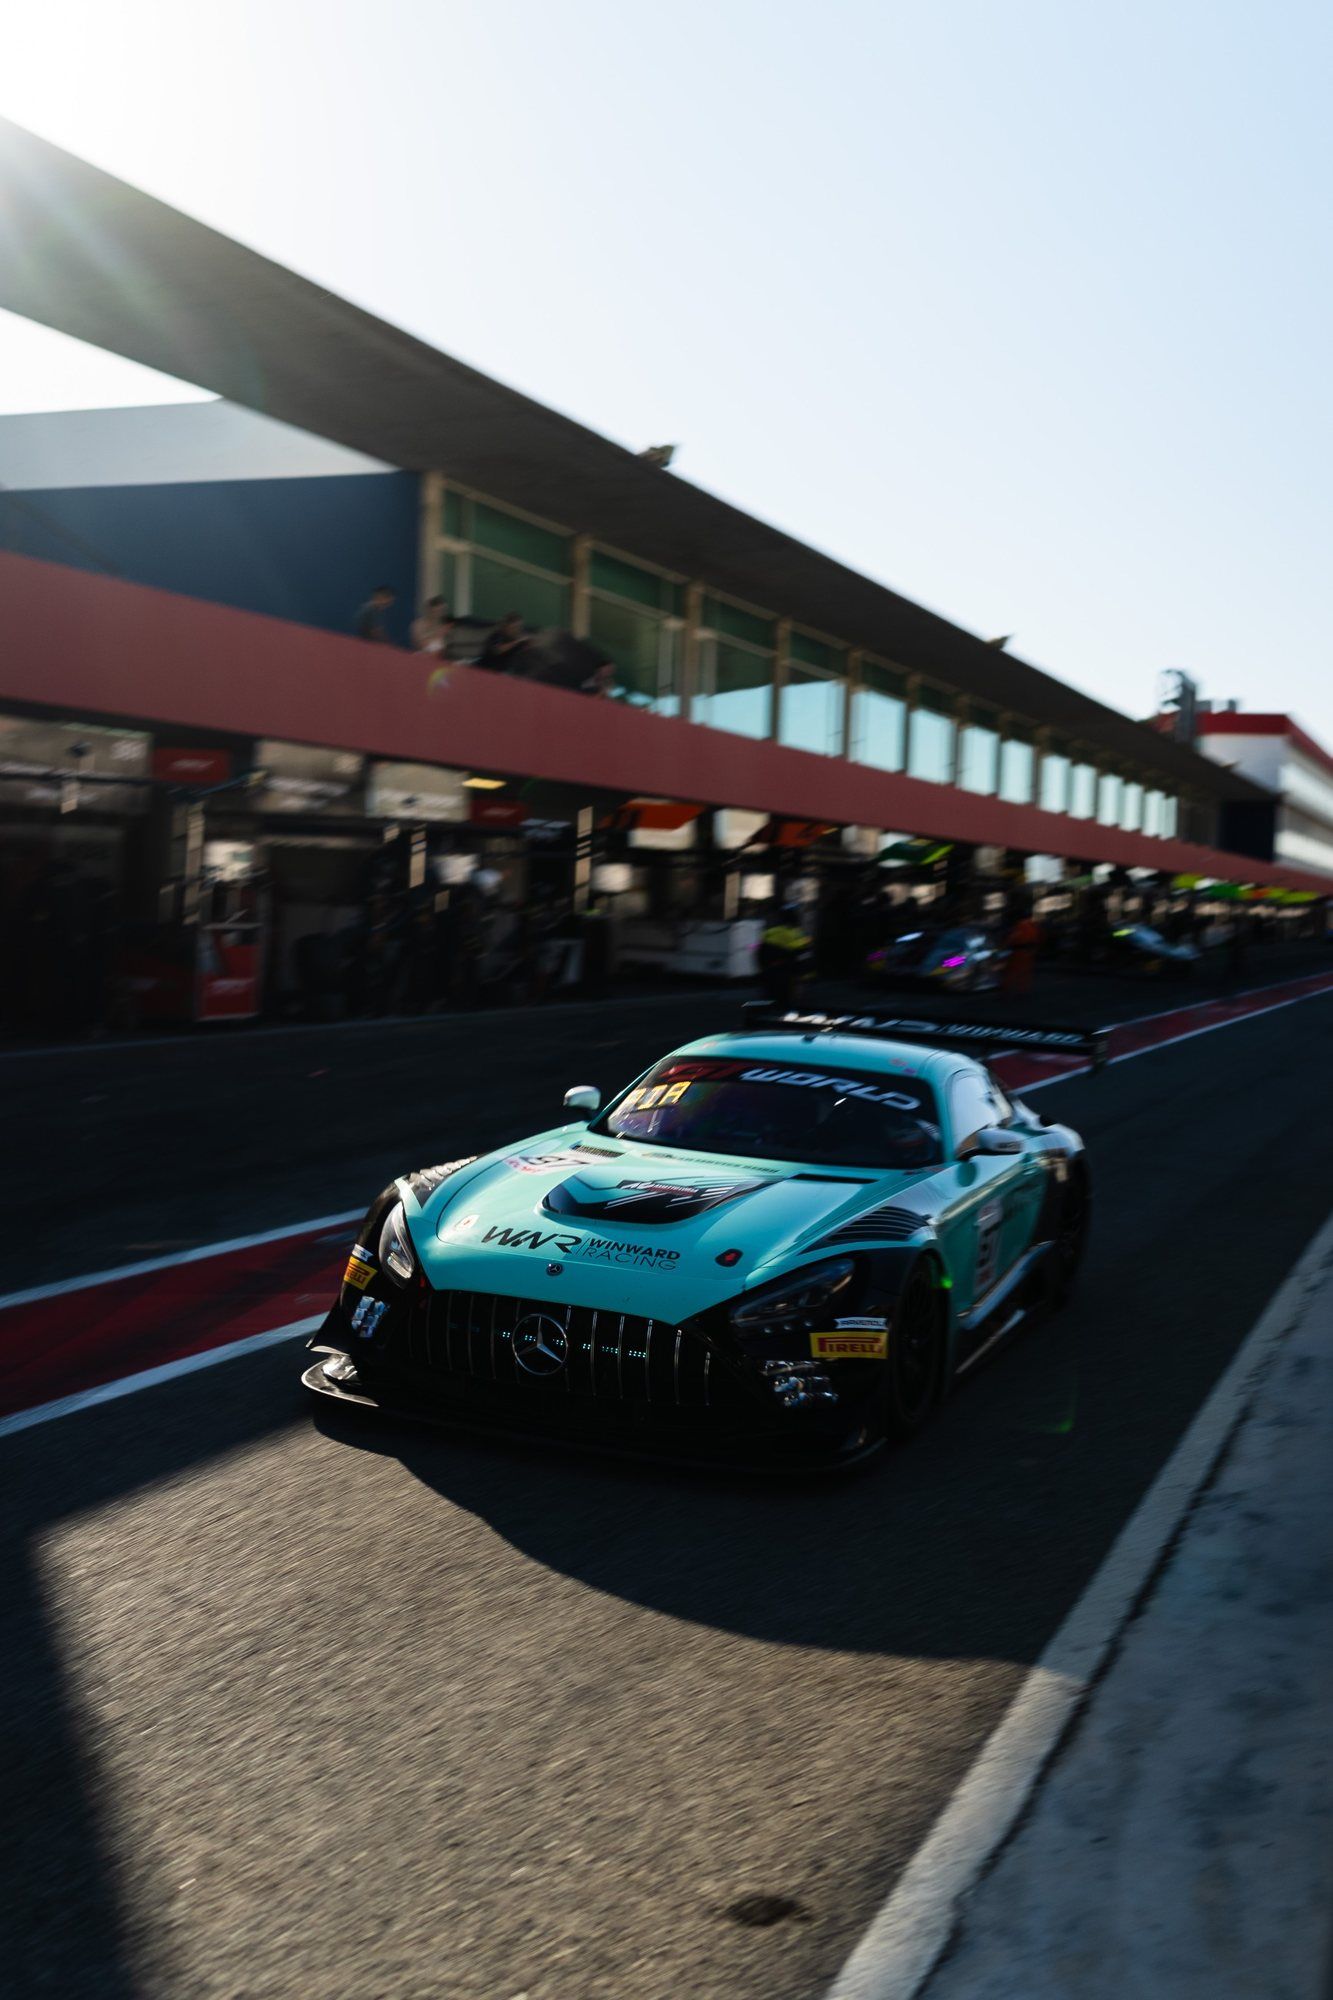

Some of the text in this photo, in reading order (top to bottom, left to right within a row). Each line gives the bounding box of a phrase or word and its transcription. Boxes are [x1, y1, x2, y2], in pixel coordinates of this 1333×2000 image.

[739, 1067, 921, 1110] WORLD
[582, 1247, 678, 1270] RACING
[588, 1238, 681, 1260] WINWARD
[818, 1337, 883, 1354] PIRELLI
